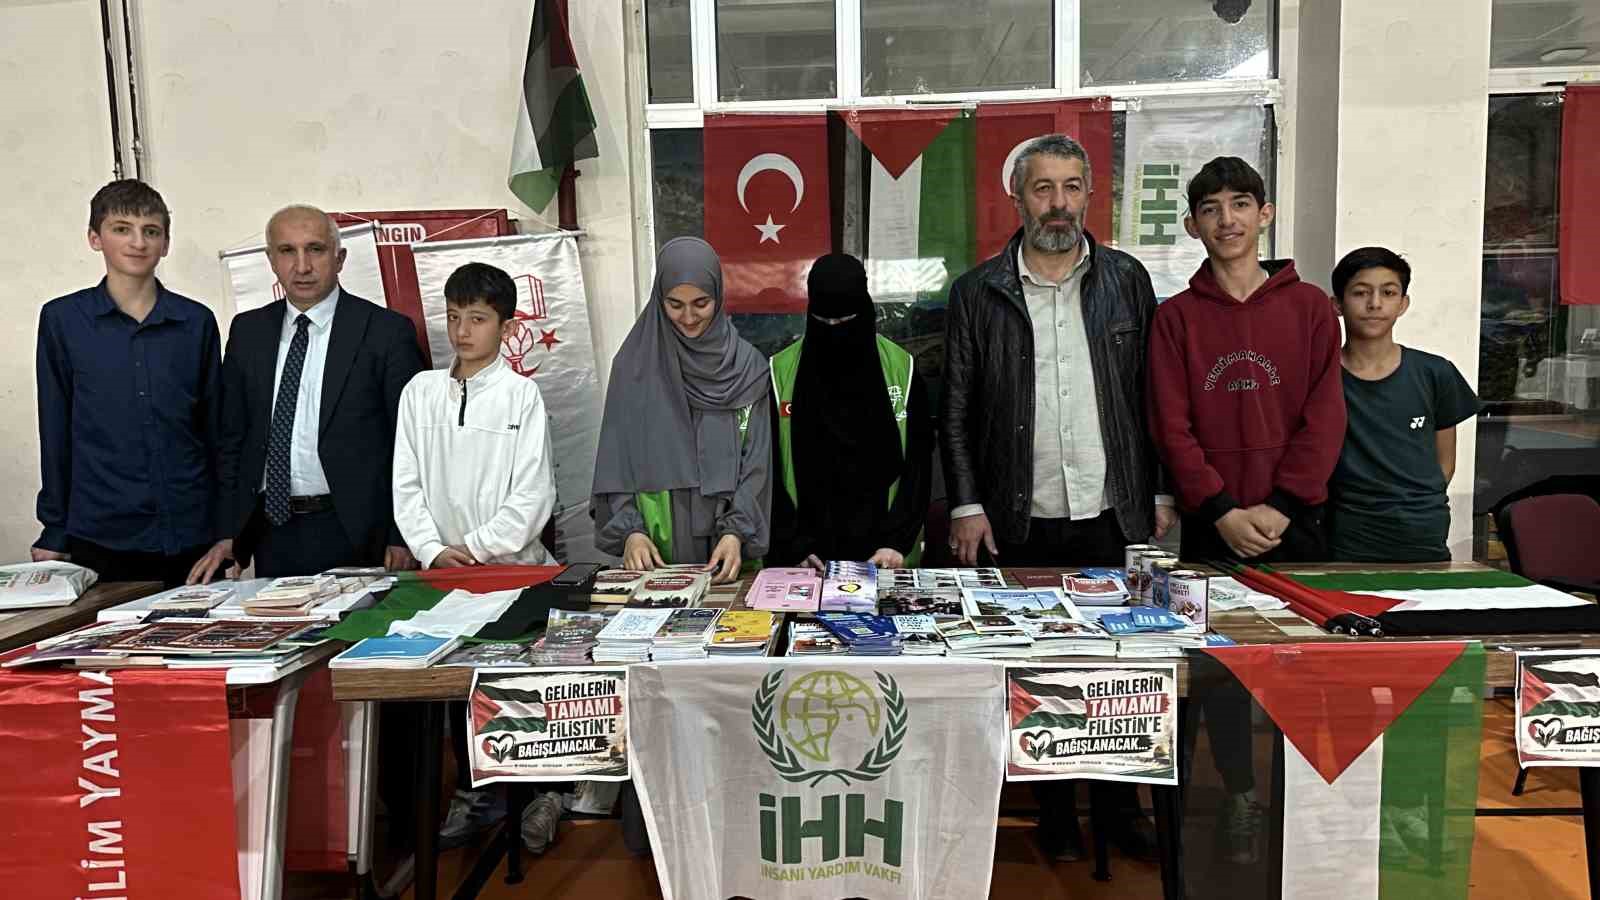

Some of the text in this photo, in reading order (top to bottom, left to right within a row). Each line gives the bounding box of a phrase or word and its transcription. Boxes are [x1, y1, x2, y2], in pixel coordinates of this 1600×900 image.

[545, 679, 616, 701] GELİRLERİN
[1087, 676, 1163, 698] GELİRLERİN
[548, 697, 615, 720] TAMAMI
[1090, 695, 1162, 717] TAMAMI
[549, 718, 616, 739] FİLİSTİN'E
[1088, 716, 1162, 736] FİLİSTİN'E
[518, 738, 605, 758] BAĞIŞLANACAK...
[1055, 737, 1149, 756] BAĞIŞLANACAK...
[759, 792, 904, 868] İHH
[808, 861, 861, 880] YARDIM
